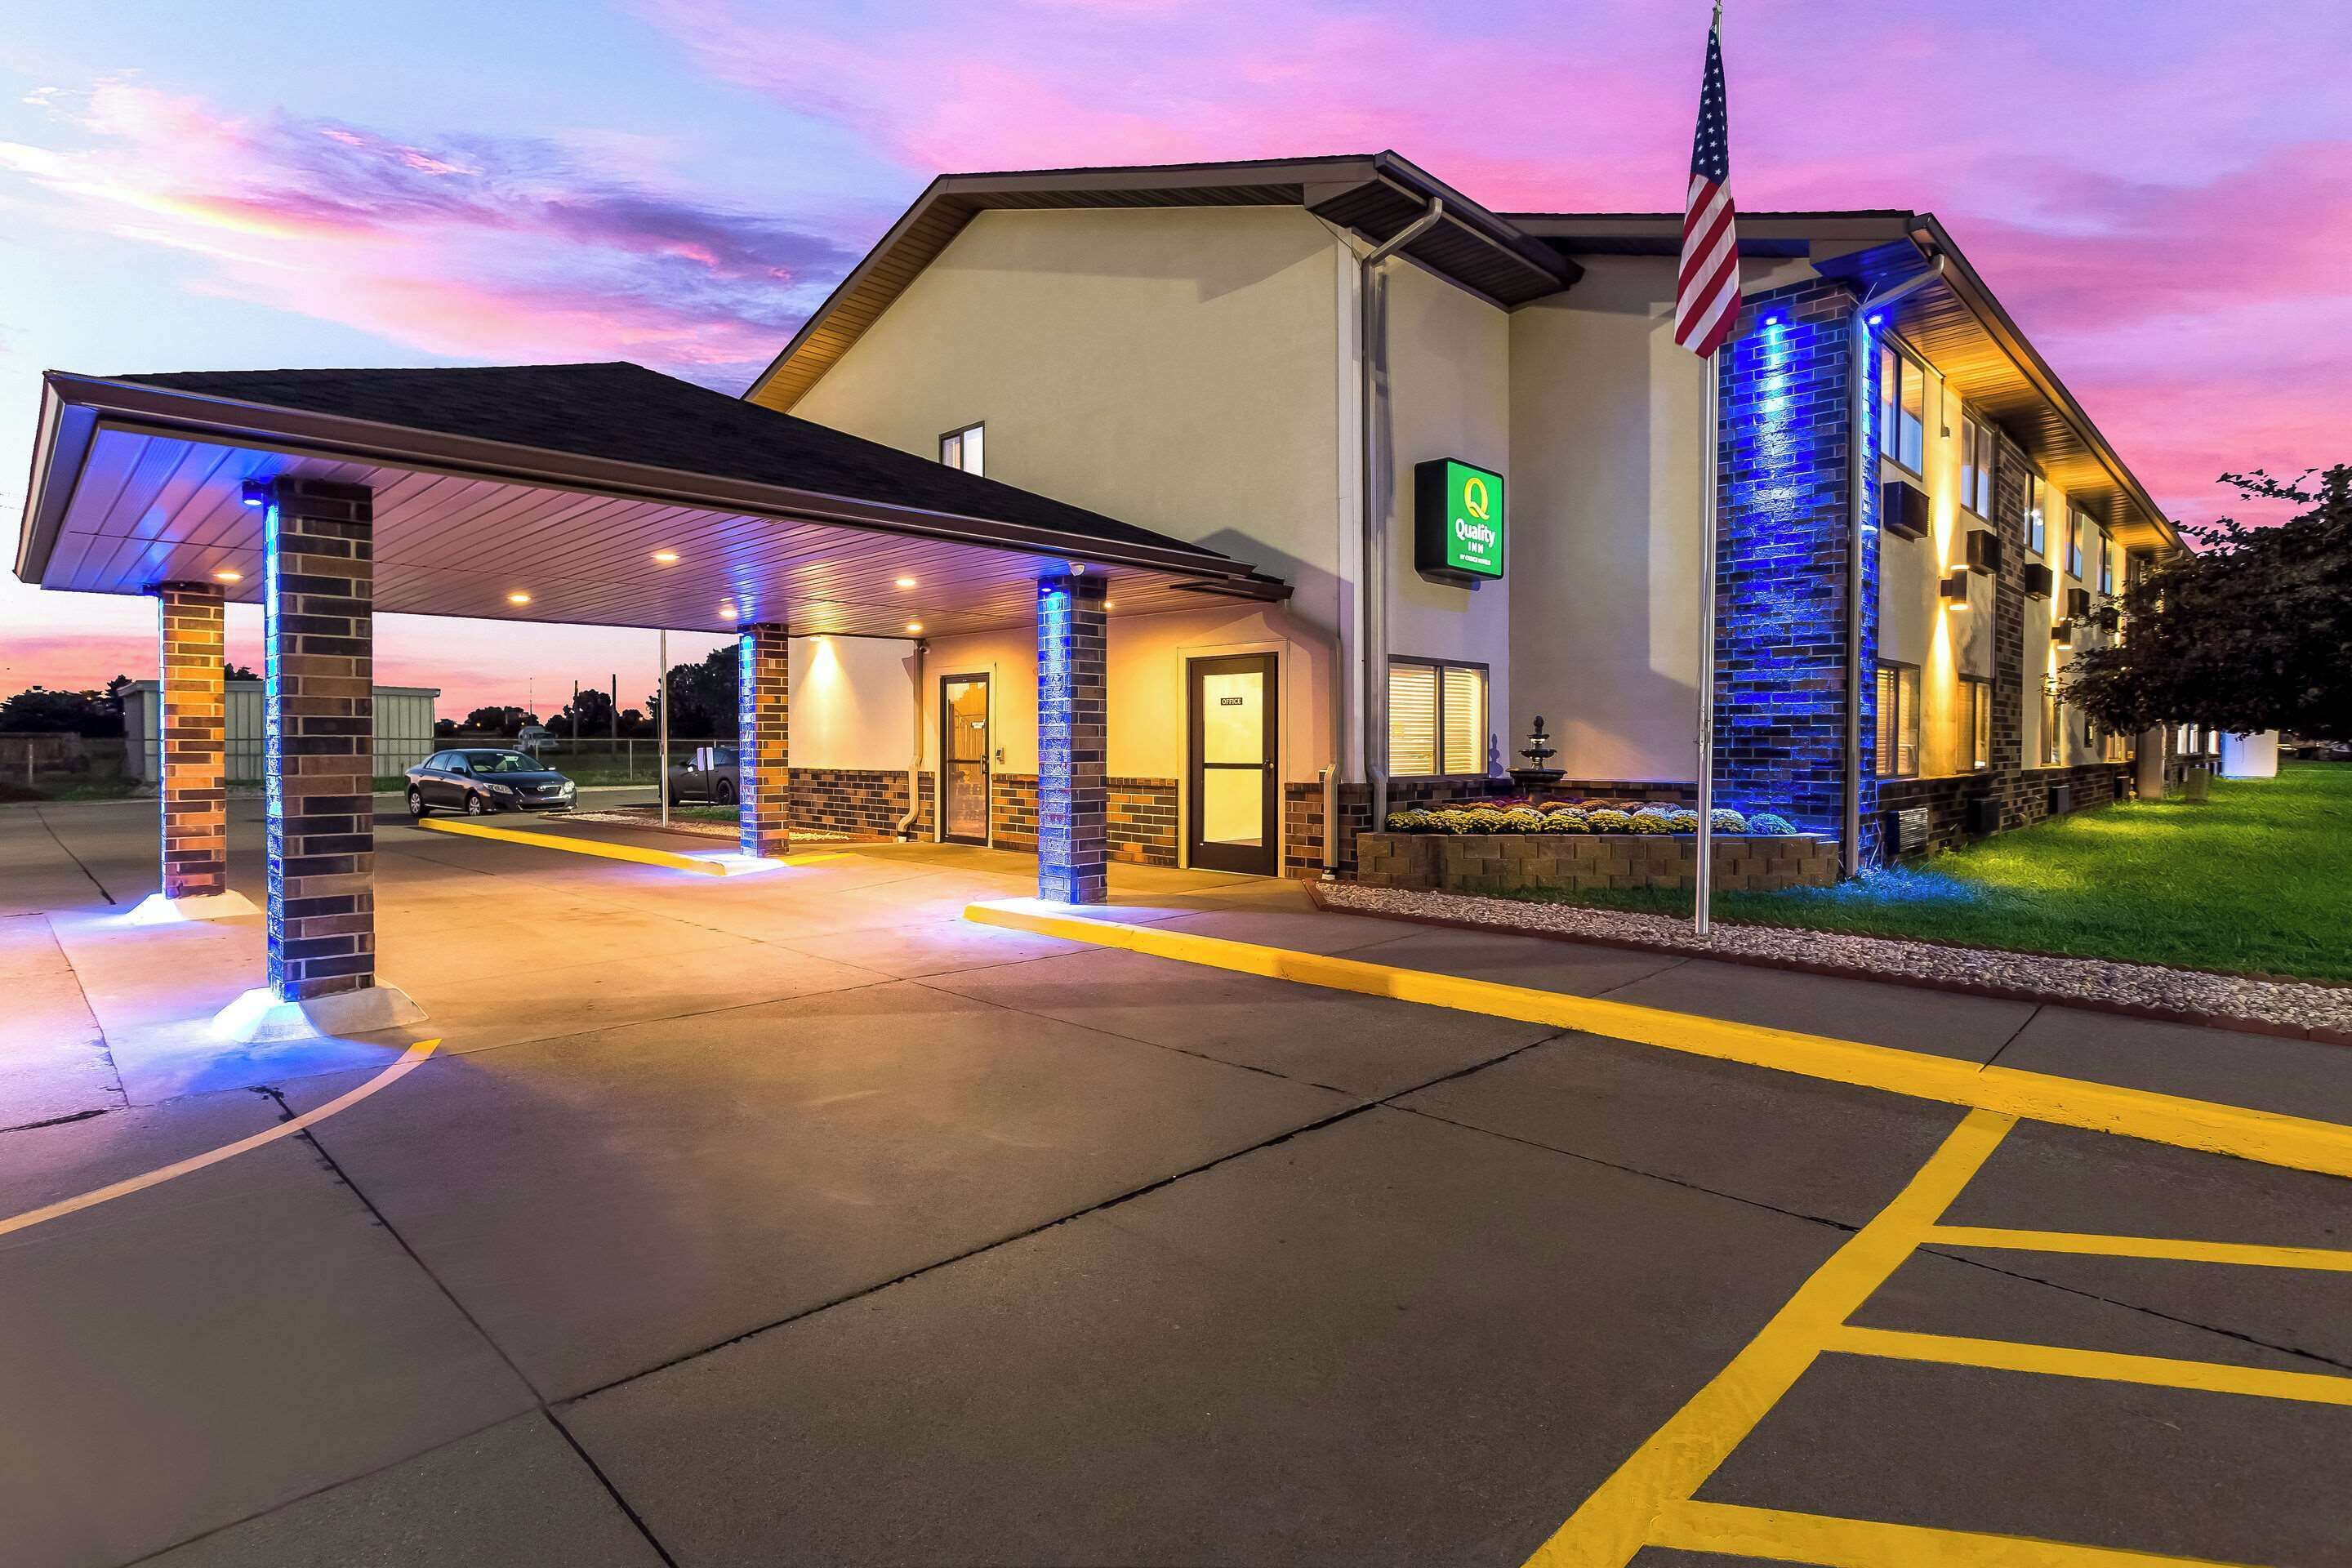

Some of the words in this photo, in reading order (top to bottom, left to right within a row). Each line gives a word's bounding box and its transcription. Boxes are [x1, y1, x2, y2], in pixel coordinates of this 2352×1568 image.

[1464, 478, 1490, 519] Q
[1455, 518, 1495, 548] Quality
[1468, 541, 1484, 554] INN
